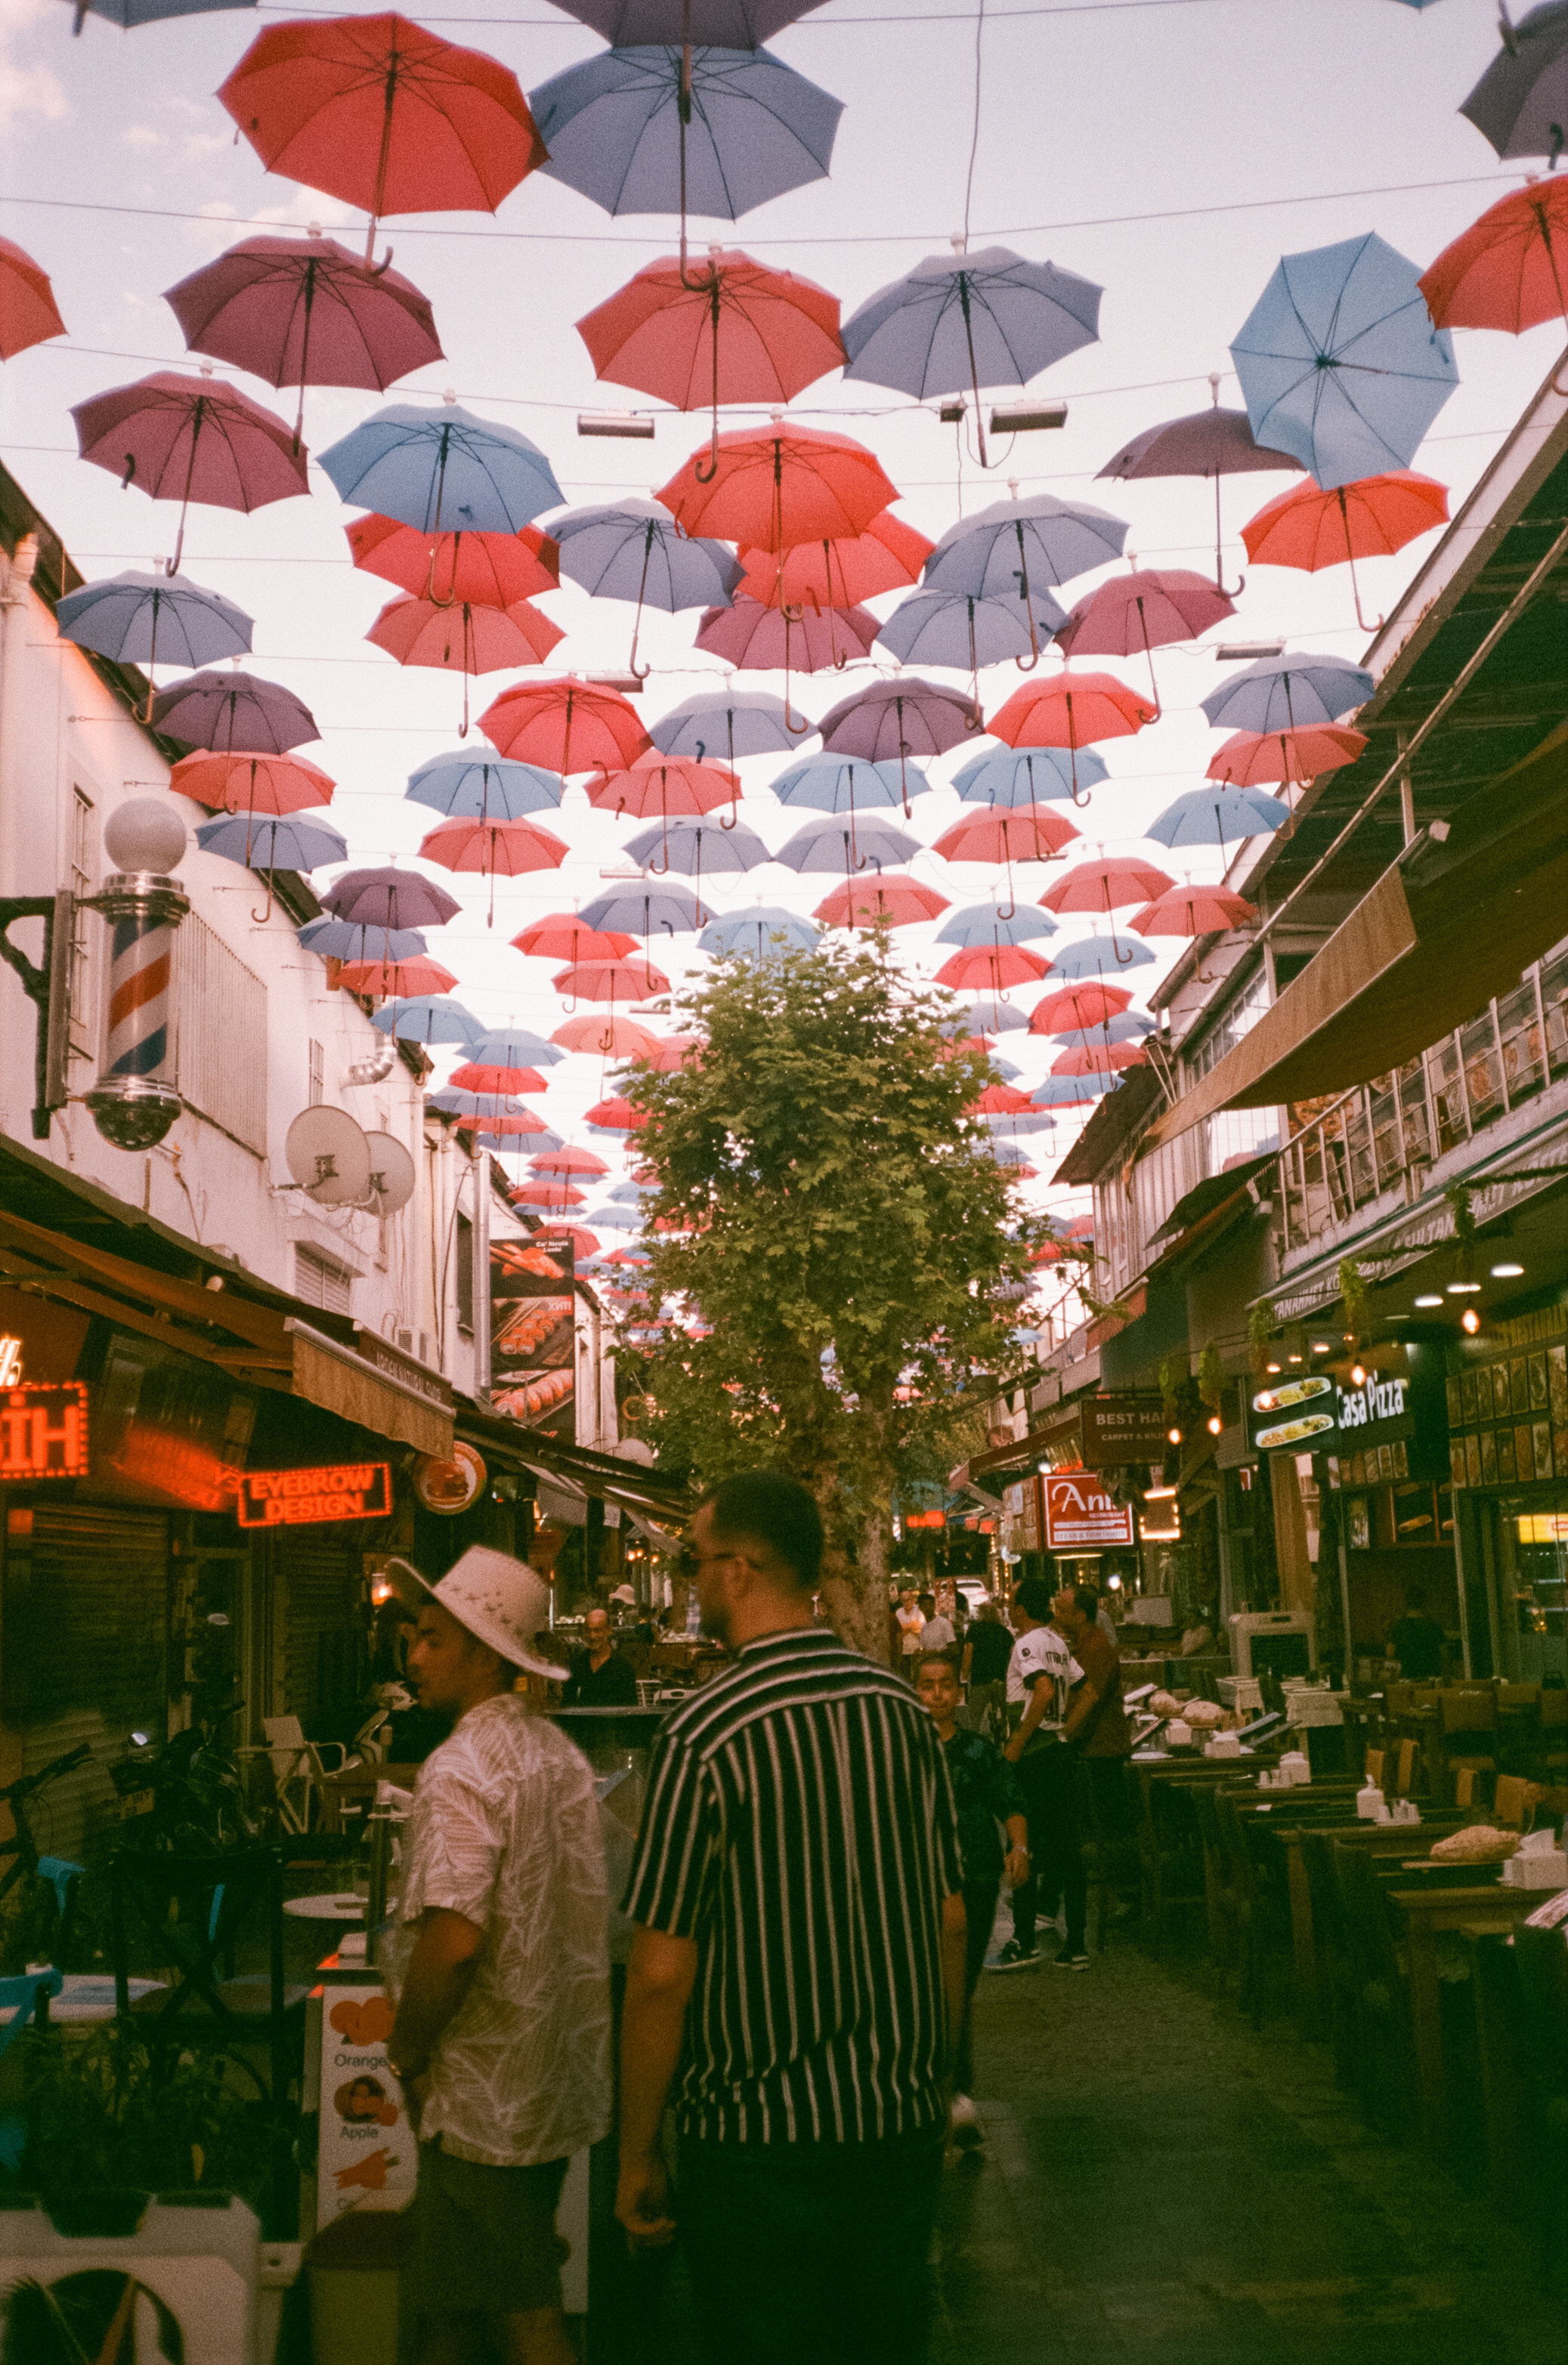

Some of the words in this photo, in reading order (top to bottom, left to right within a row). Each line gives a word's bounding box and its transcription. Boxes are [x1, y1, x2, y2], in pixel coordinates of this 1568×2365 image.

[1336, 1386, 1367, 1430] Casa
[1366, 1369, 1405, 1421] Pizza
[0, 1390, 79, 1470] İH
[1096, 1412, 1134, 1426] BEST
[251, 1468, 374, 1500] EYEBROW
[265, 1492, 363, 1519] DESIGN
[334, 2053, 387, 2070] Orange
[341, 2126, 379, 2140] Apple
